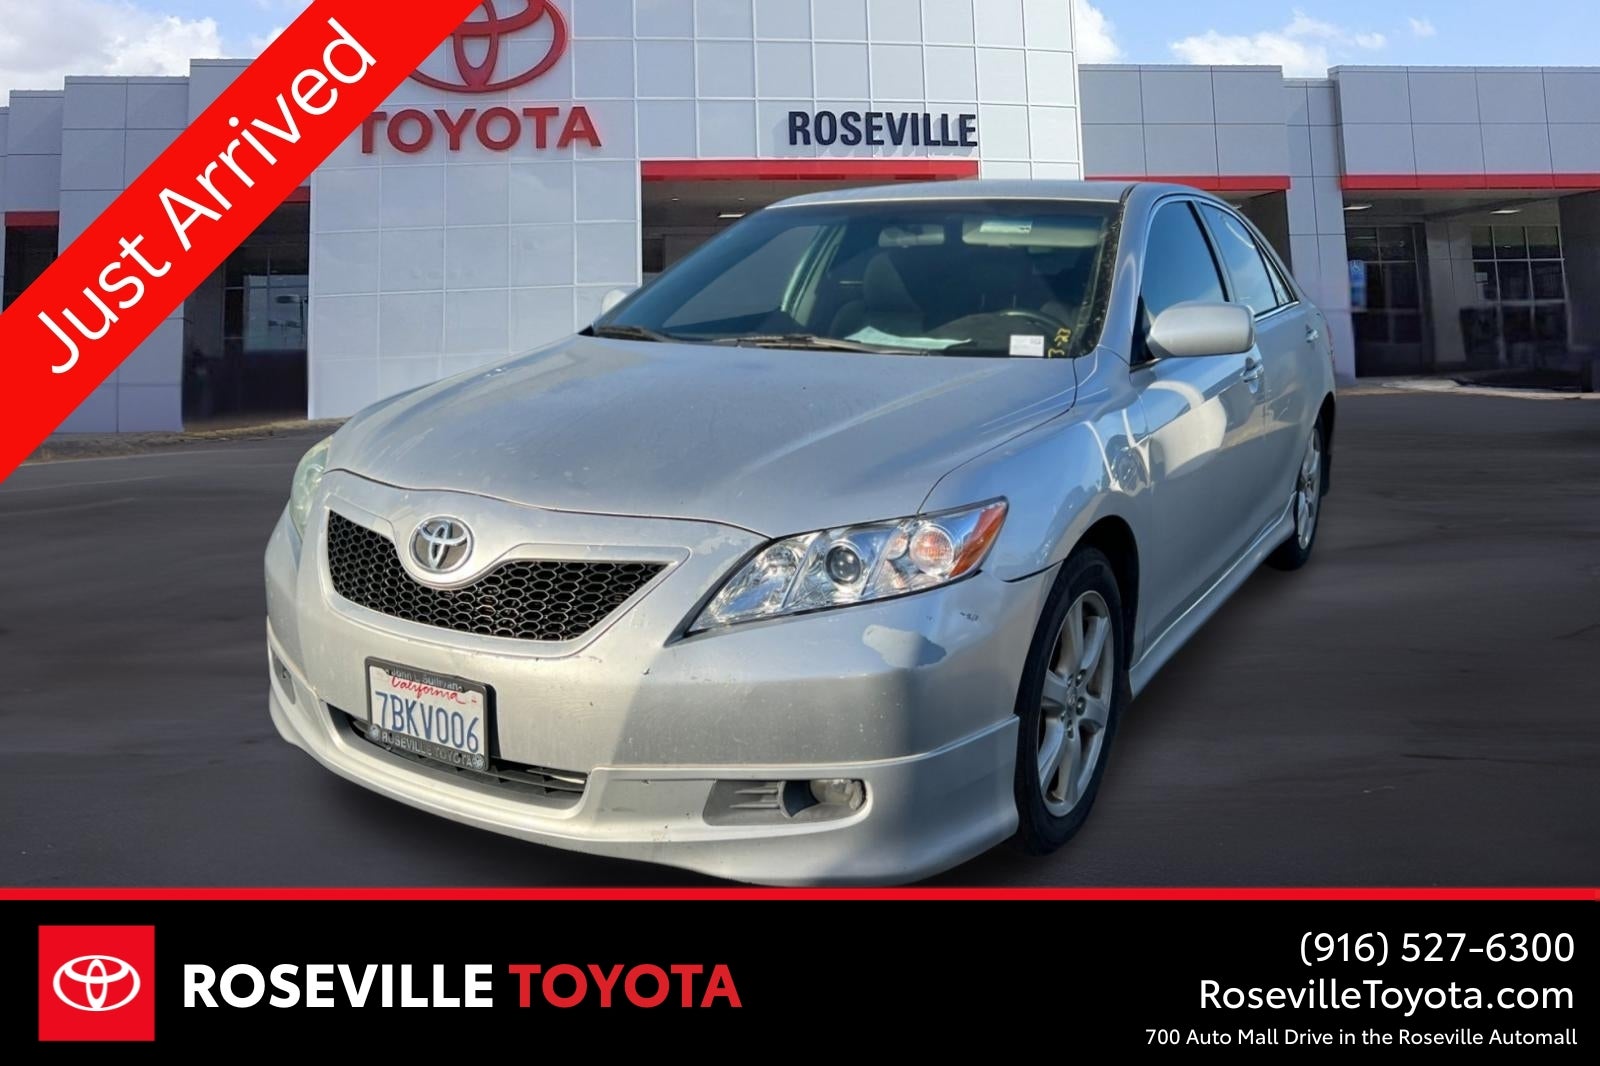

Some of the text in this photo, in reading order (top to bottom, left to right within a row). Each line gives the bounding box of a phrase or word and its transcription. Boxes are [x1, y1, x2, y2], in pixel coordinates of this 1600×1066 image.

[361, 105, 603, 154] TOYOTA
[788, 110, 979, 148] ROSEVILLE
[390, 675, 466, 704] California
[375, 690, 479, 753] 7BKV006
[381, 731, 433, 756] ROSEVILLE
